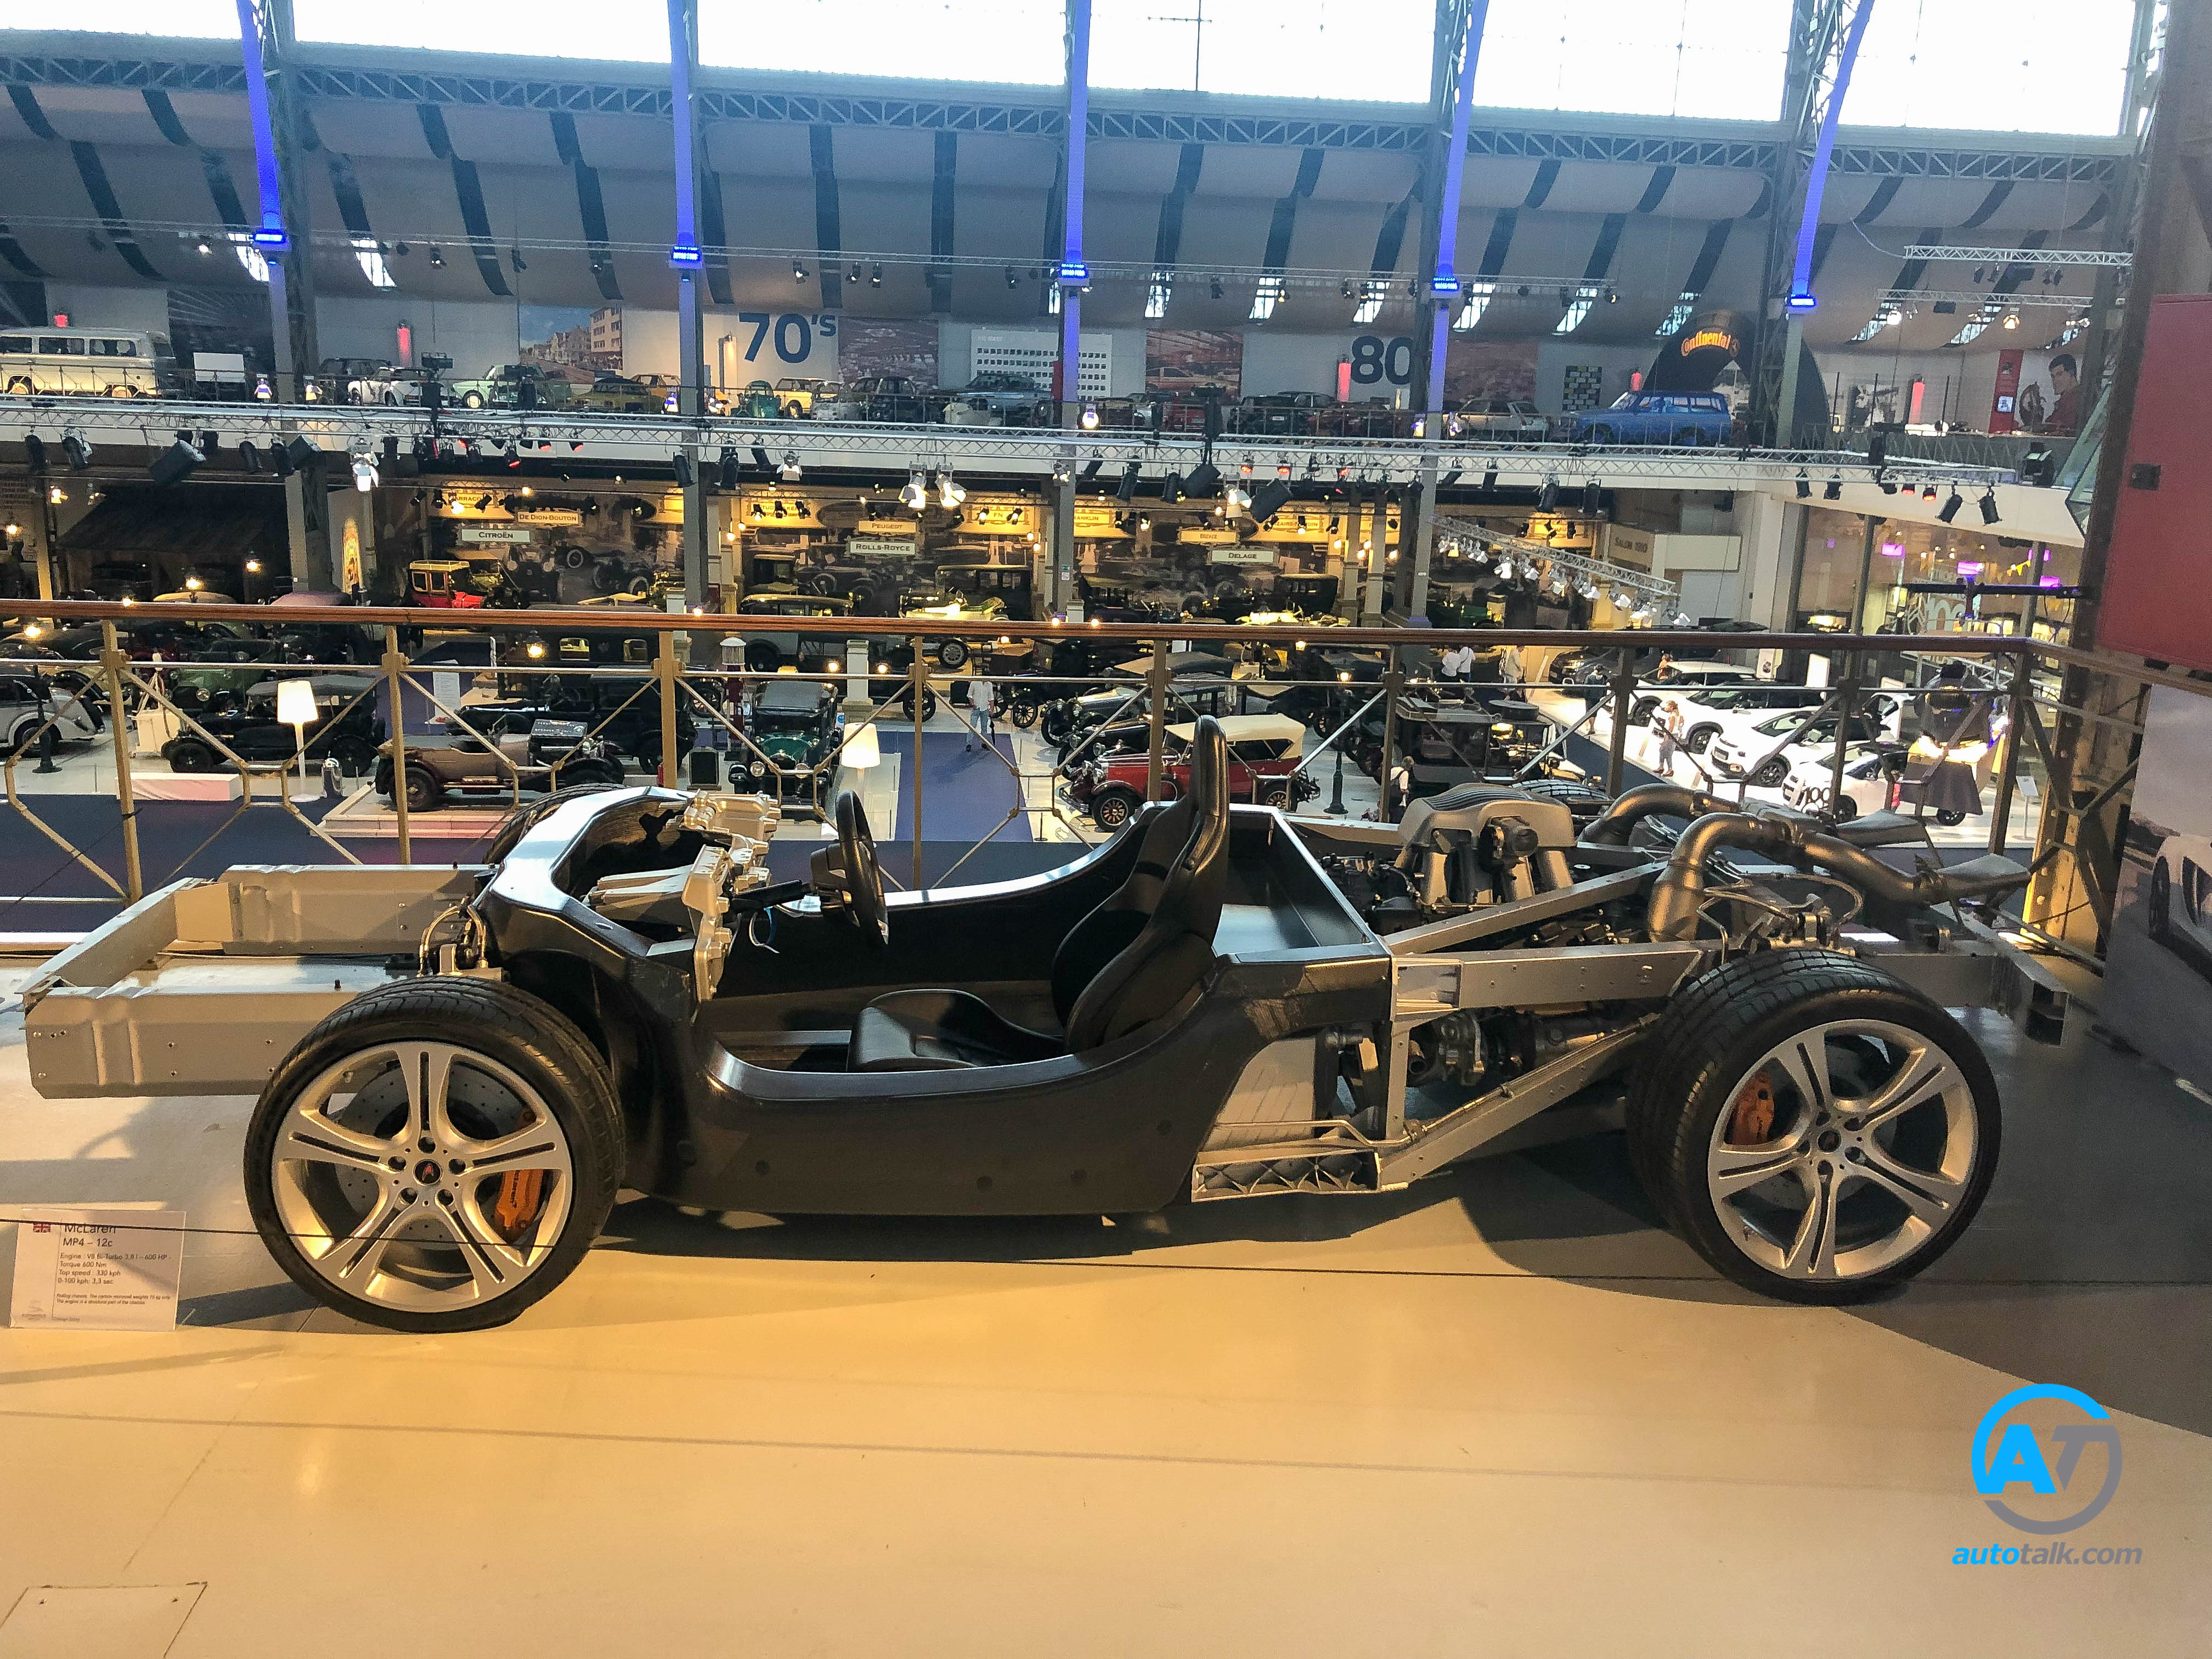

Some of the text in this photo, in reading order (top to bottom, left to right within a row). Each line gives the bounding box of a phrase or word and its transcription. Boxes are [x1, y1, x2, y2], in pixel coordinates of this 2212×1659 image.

[1681, 331, 1731, 357] Continental
[1351, 335, 1413, 385] 80
[64, 1224, 117, 1234] McLaren
[63, 1238, 84, 1246] MP4
[97, 1238, 113, 1247] 12c
